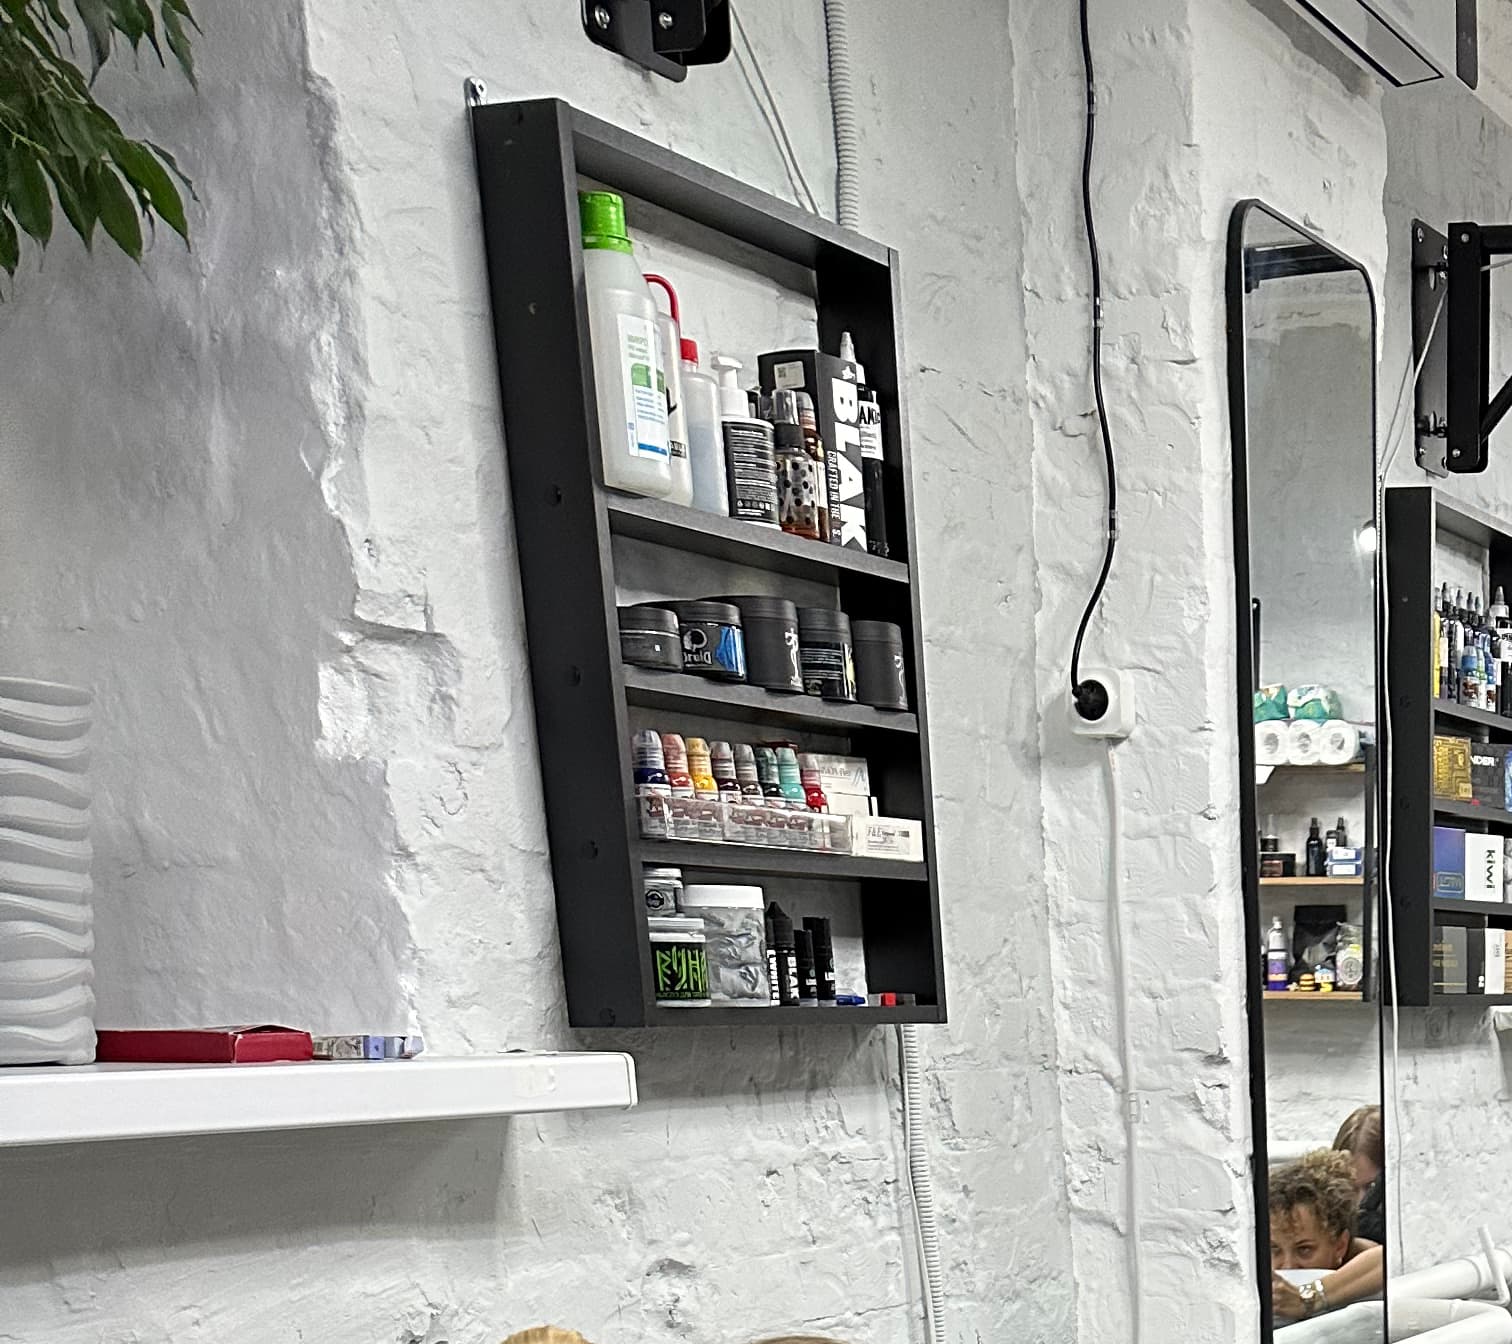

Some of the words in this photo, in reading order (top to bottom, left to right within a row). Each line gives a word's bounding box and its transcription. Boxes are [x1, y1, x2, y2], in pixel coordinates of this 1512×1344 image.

[827, 451, 840, 490] CRAFTED
[832, 377, 868, 552] BLAK
[830, 490, 840, 502] IN
[830, 503, 841, 521] THE
[1486, 849, 1496, 889] kiwi
[787, 956, 800, 999] BLAK
